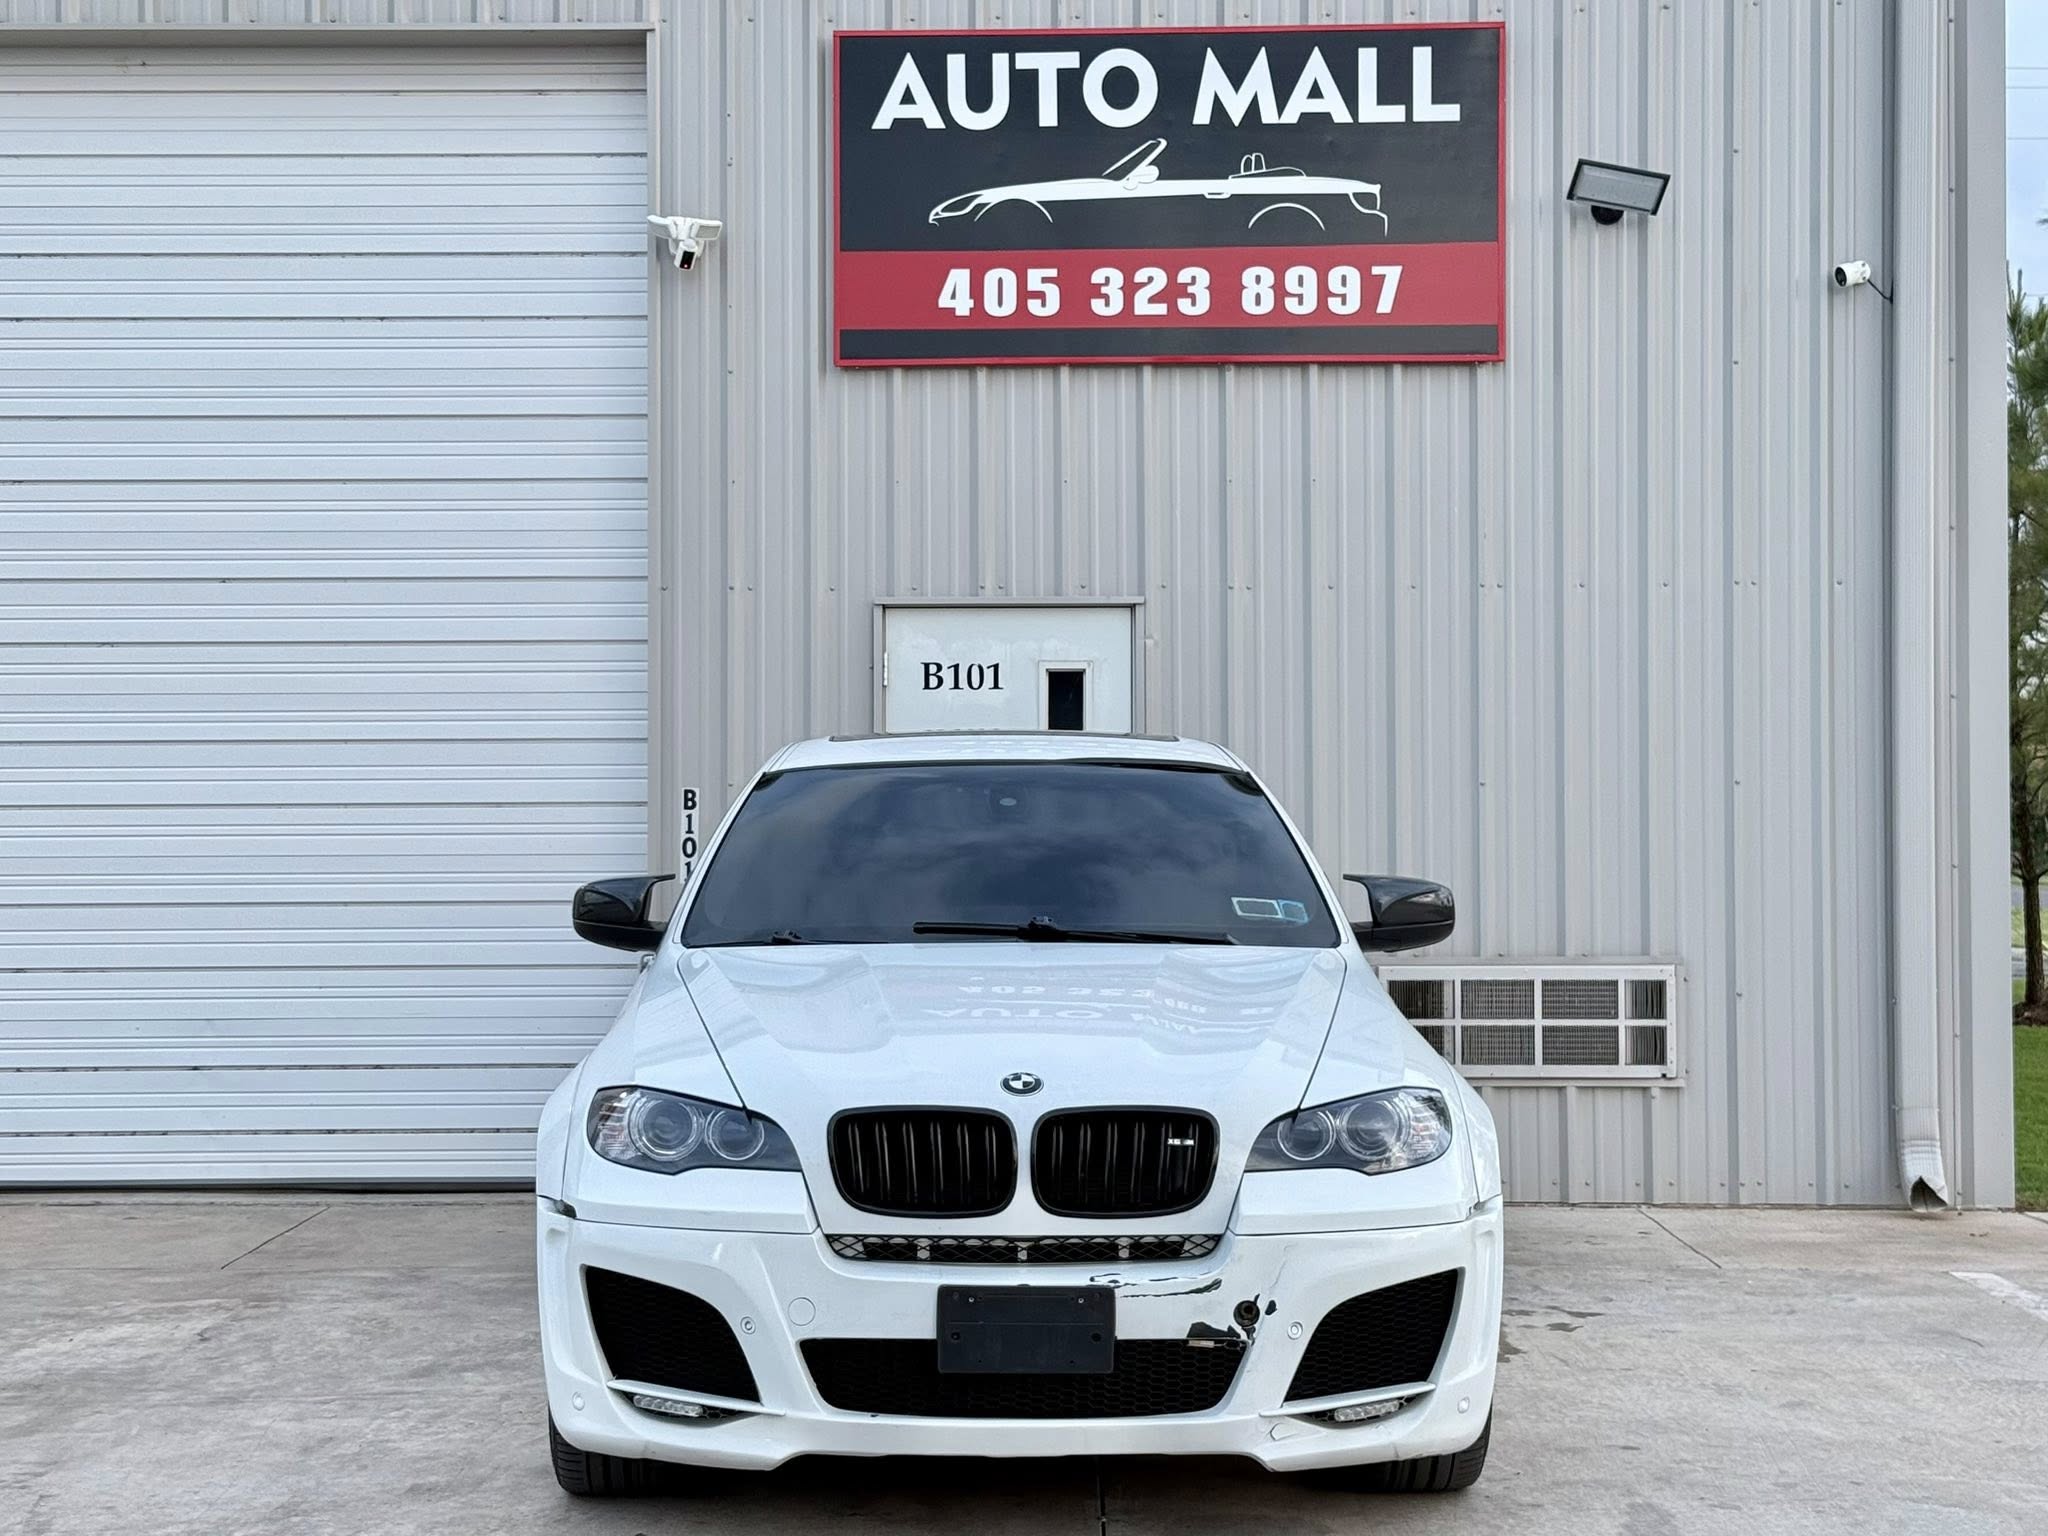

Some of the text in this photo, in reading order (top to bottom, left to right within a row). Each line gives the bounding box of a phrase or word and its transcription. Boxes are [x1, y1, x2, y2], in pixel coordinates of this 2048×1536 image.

[872, 46, 1461, 130] AUTO MALL
[939, 265, 1403, 317] 405 323 8997
[921, 662, 1004, 690] B101
